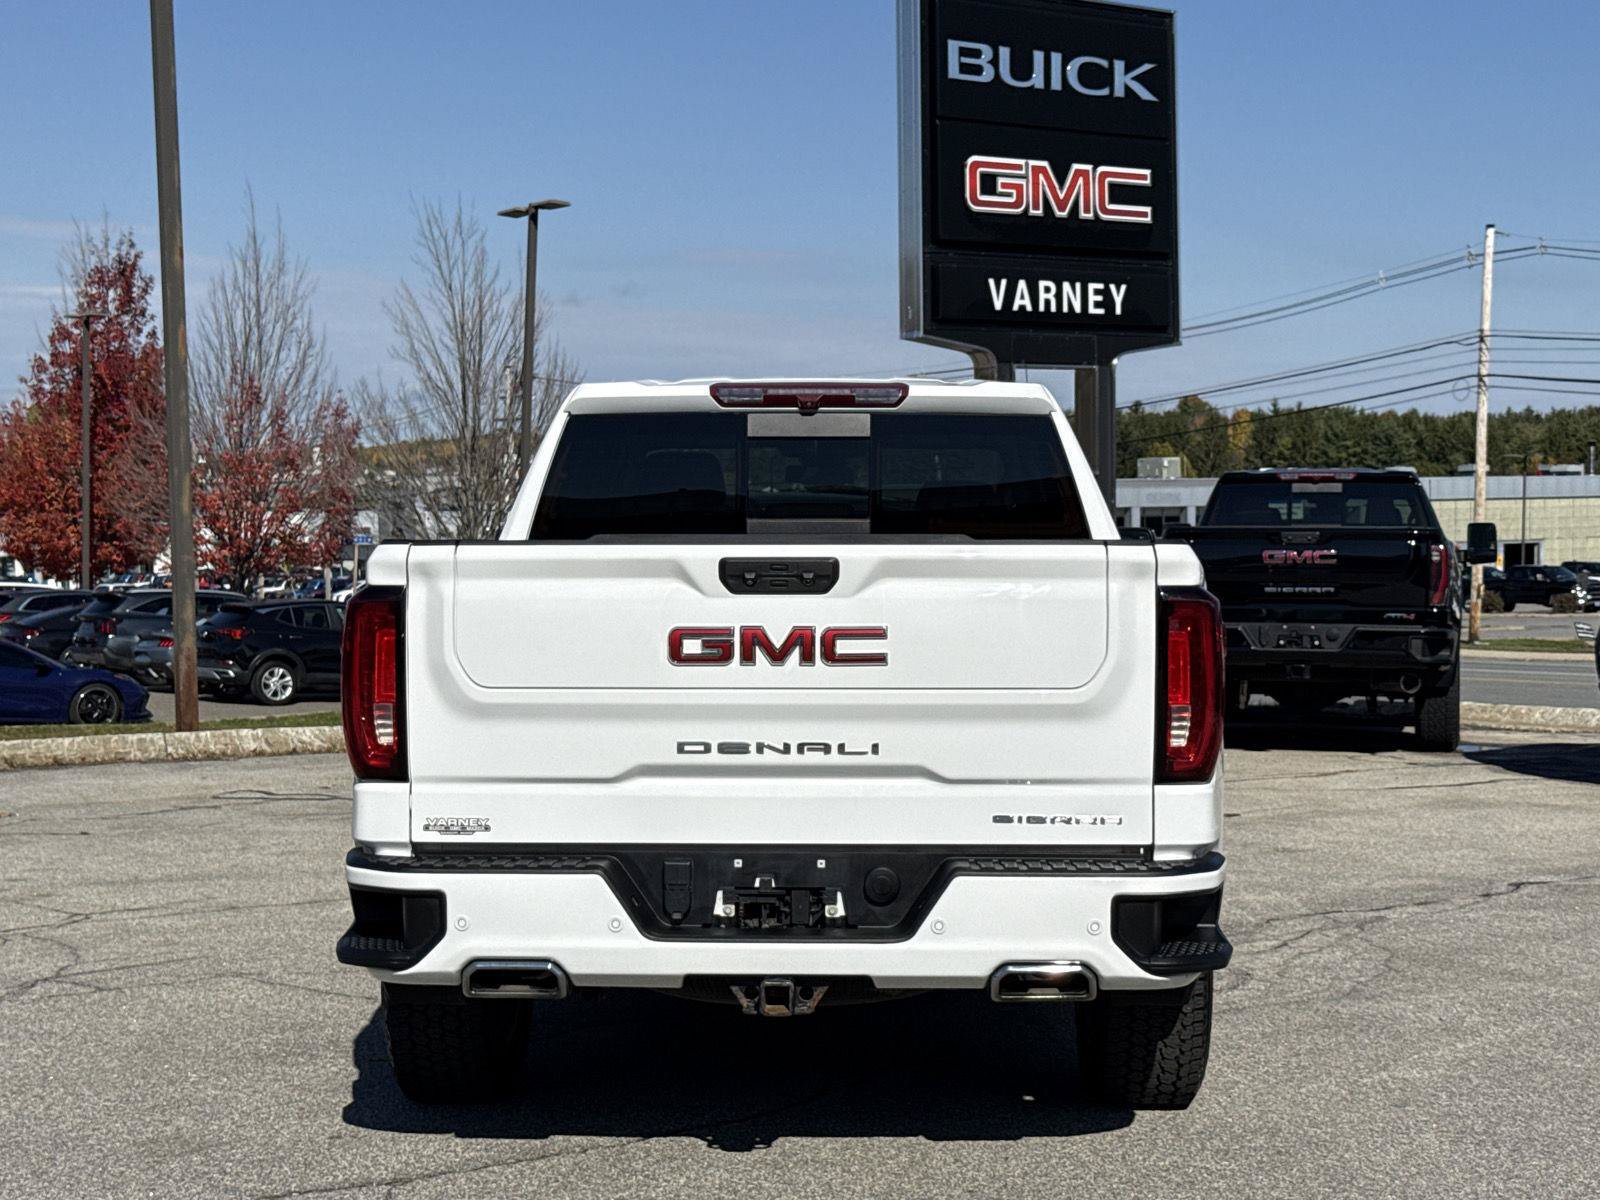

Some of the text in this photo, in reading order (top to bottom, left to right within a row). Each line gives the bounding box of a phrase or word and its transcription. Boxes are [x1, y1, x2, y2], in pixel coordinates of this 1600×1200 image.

[947, 39, 1159, 102] BUICK
[965, 155, 1152, 223] GMC
[987, 278, 1128, 316] VARNEY
[1262, 549, 1338, 564] GMC
[667, 625, 889, 667] GMC
[676, 741, 880, 756] DENALI
[425, 817, 490, 827] VARNEY
